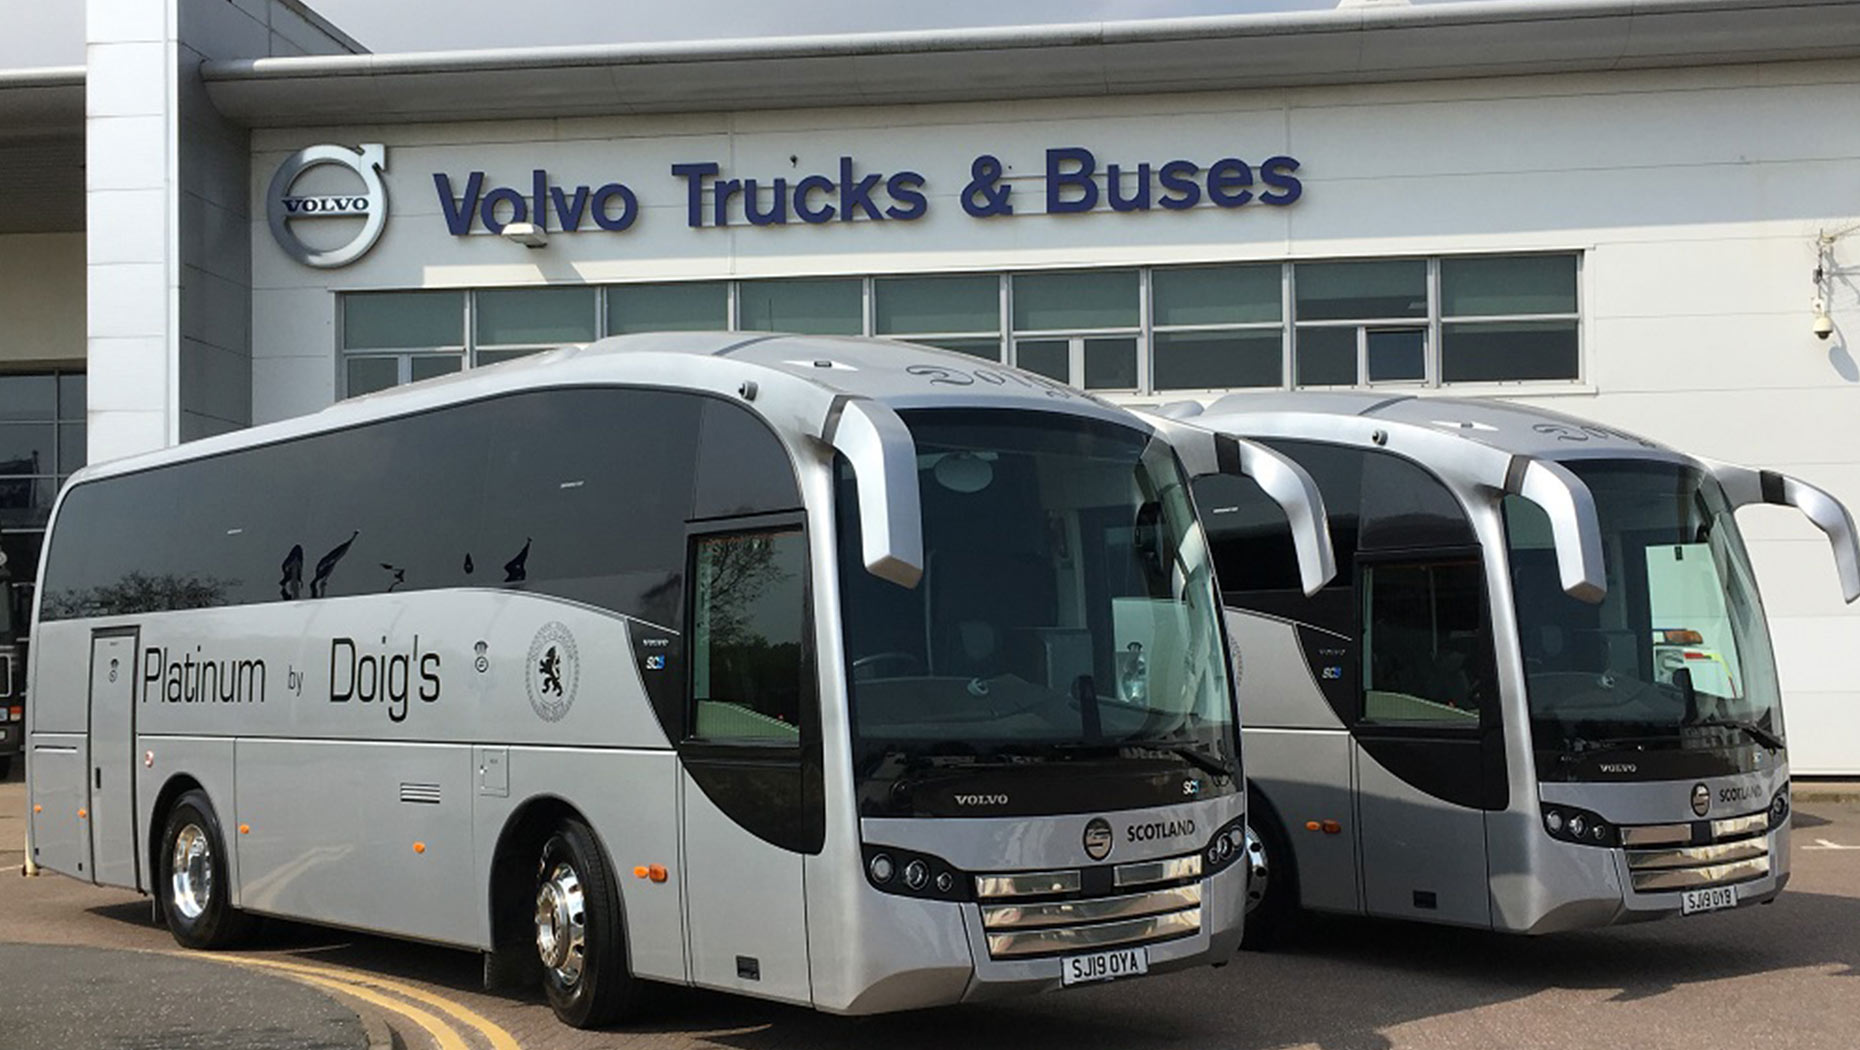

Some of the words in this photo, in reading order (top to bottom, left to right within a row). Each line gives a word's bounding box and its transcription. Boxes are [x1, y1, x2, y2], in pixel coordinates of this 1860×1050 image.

[433, 169, 638, 236] Volvo
[671, 156, 928, 228] Trucks
[959, 154, 1014, 219] &
[1045, 147, 1302, 214] Buses
[282, 197, 369, 213] VOLVO
[142, 644, 267, 703] Platinum
[288, 664, 304, 697] by
[329, 634, 441, 723] Doig's
[1599, 763, 1637, 773] VOLVO
[954, 793, 1009, 806] VOLVO
[1719, 786, 1763, 803] SCOTLAND
[1127, 819, 1196, 843] SCOTLAND
[1072, 956, 1107, 978] SJ19
[1109, 951, 1138, 973] OYA
